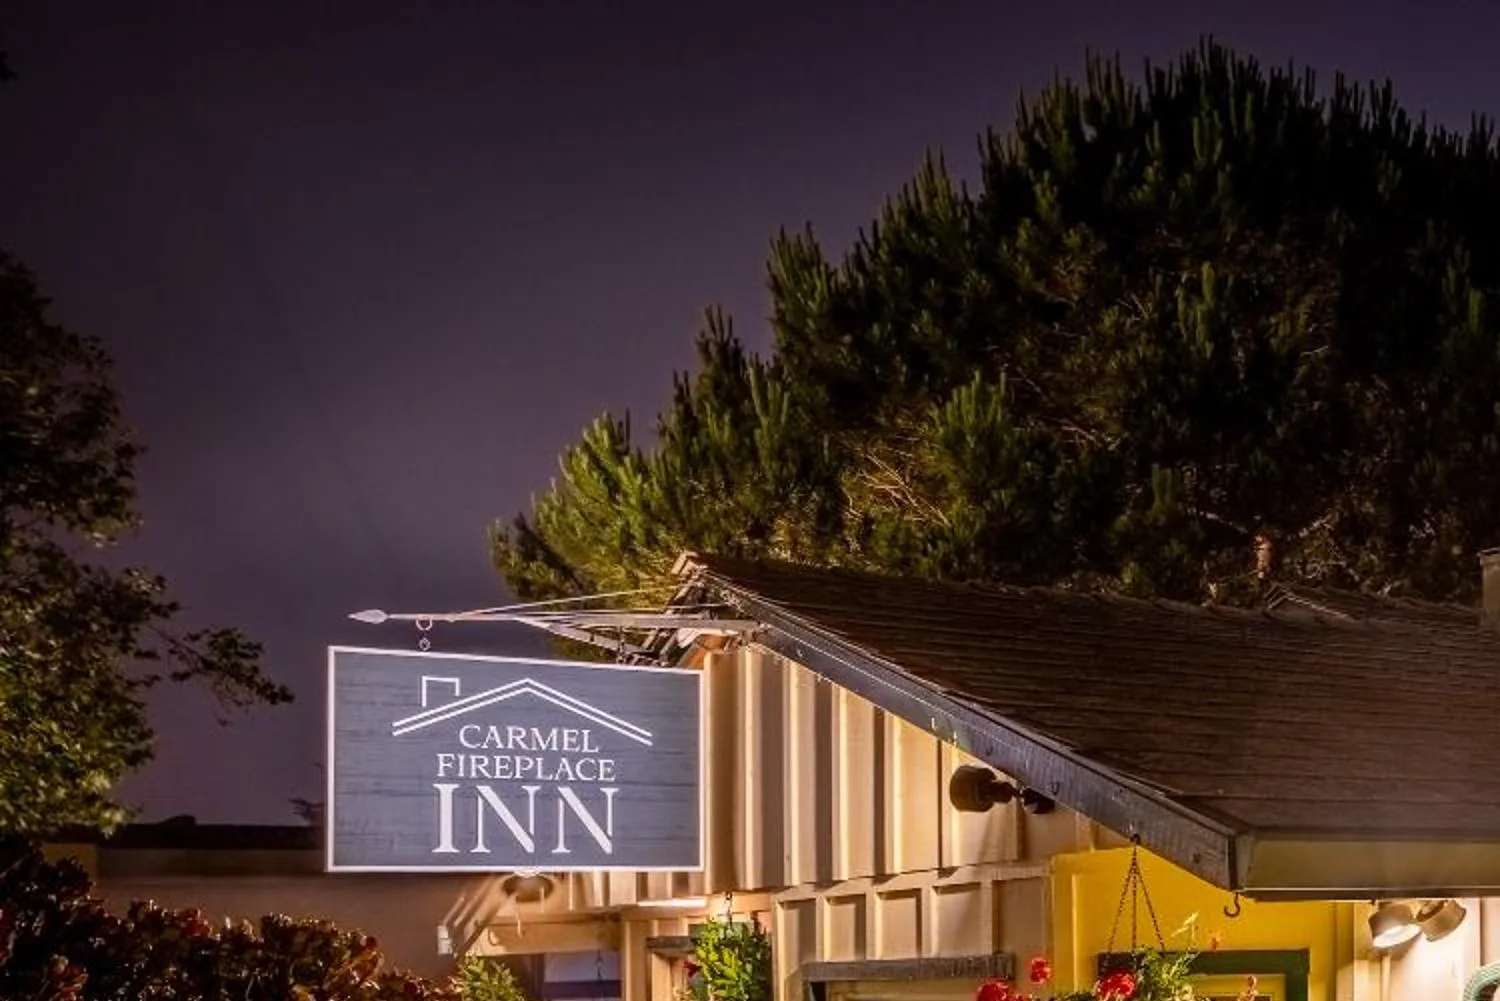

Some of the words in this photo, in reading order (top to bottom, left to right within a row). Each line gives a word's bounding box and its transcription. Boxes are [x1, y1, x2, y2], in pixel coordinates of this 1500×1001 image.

[458, 723, 600, 753] CARMEL
[435, 752, 617, 783] FIREPLACE
[431, 782, 620, 855] INN
